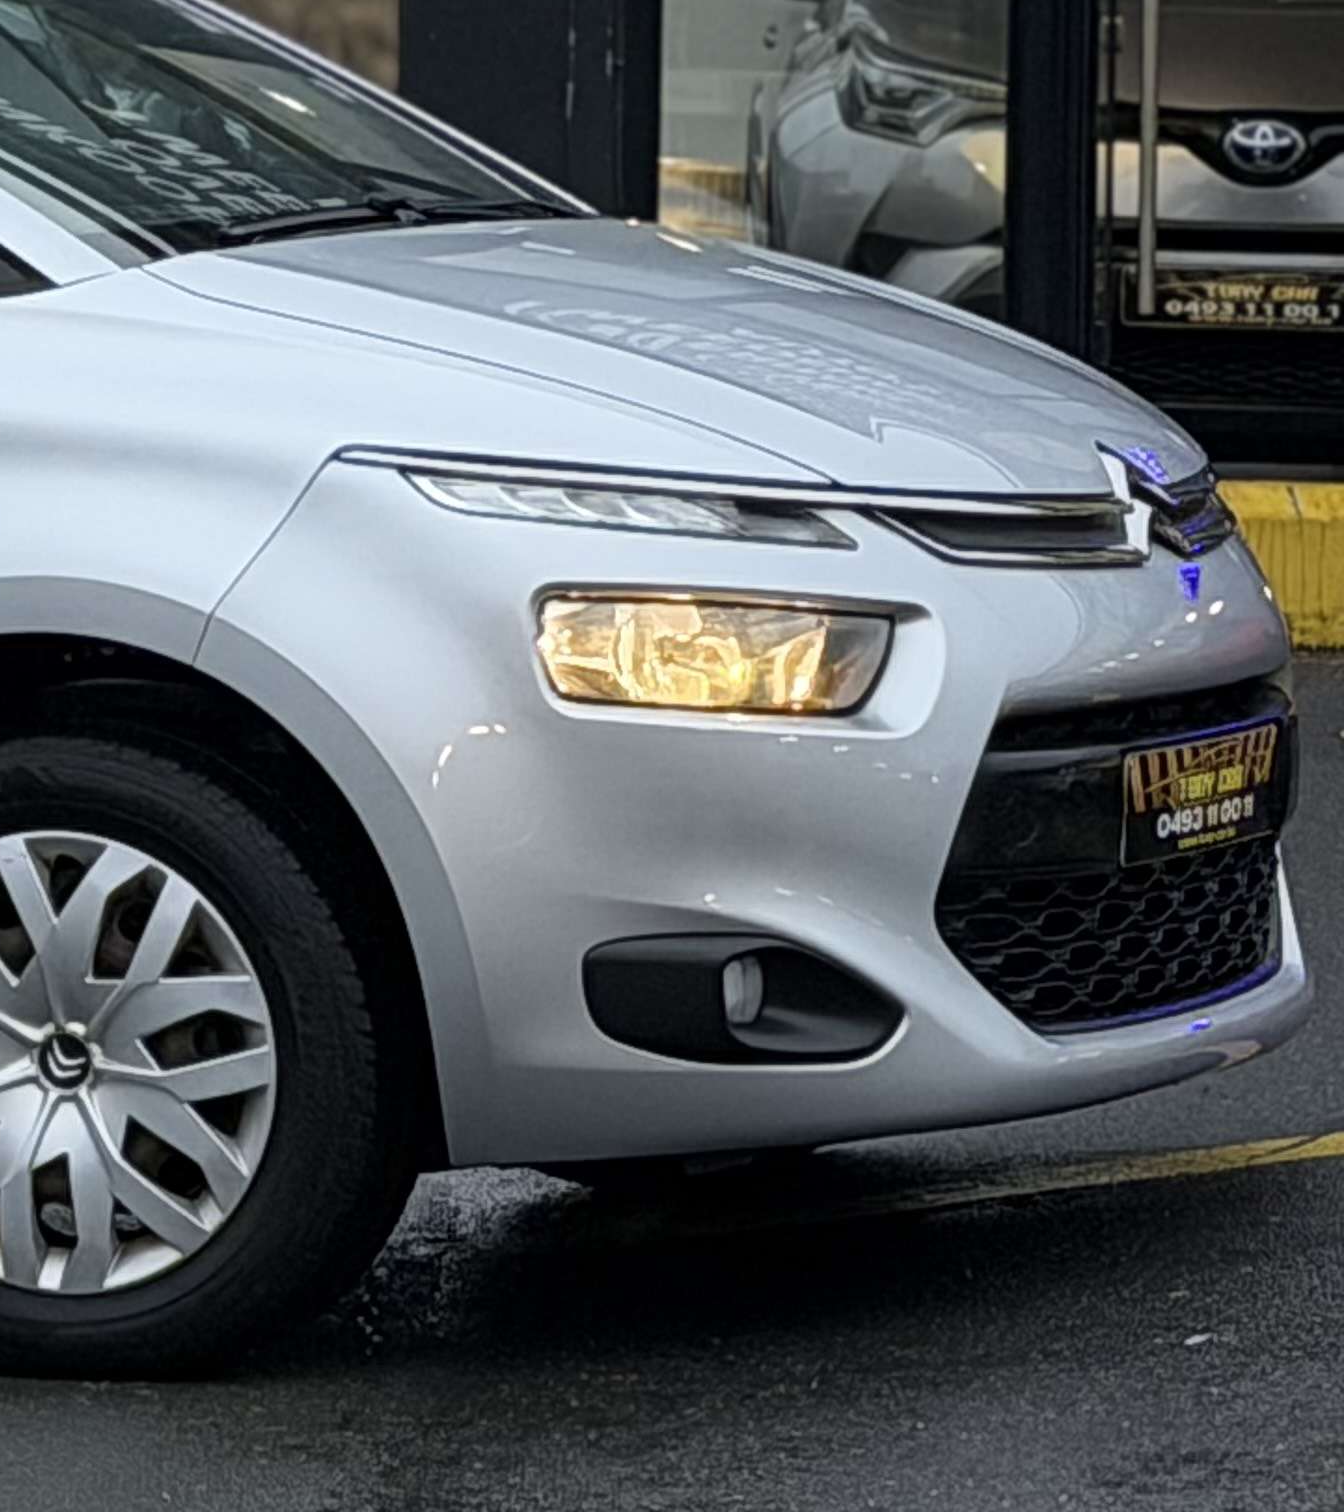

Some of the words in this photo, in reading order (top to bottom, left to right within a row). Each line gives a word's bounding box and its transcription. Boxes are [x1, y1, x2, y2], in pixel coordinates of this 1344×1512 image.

[1164, 299, 1236, 319] 0493
[1243, 302, 1275, 318] 11
[1156, 805, 1204, 839] 0493
[1220, 795, 1242, 822] 00
